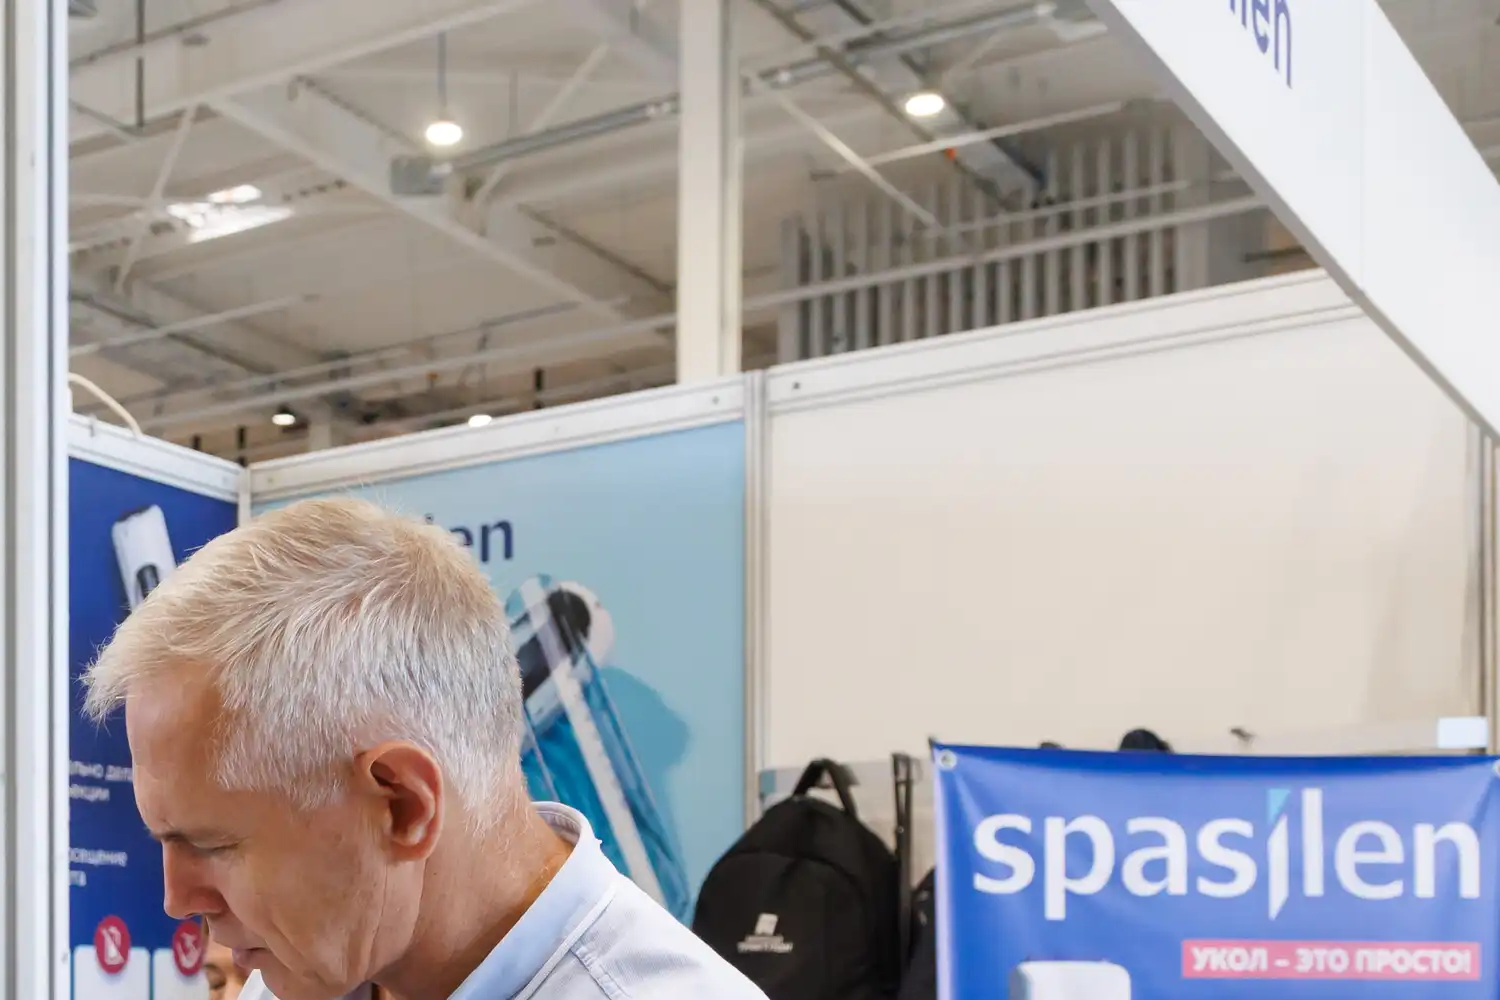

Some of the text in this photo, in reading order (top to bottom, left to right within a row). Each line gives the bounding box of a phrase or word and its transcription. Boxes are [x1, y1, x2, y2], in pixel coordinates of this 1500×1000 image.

[972, 788, 1481, 921] spasilen
[1191, 946, 1268, 972] УКОЛ
[1295, 947, 1350, 973] ЭТО
[1355, 948, 1472, 974] ПРОСТО!
